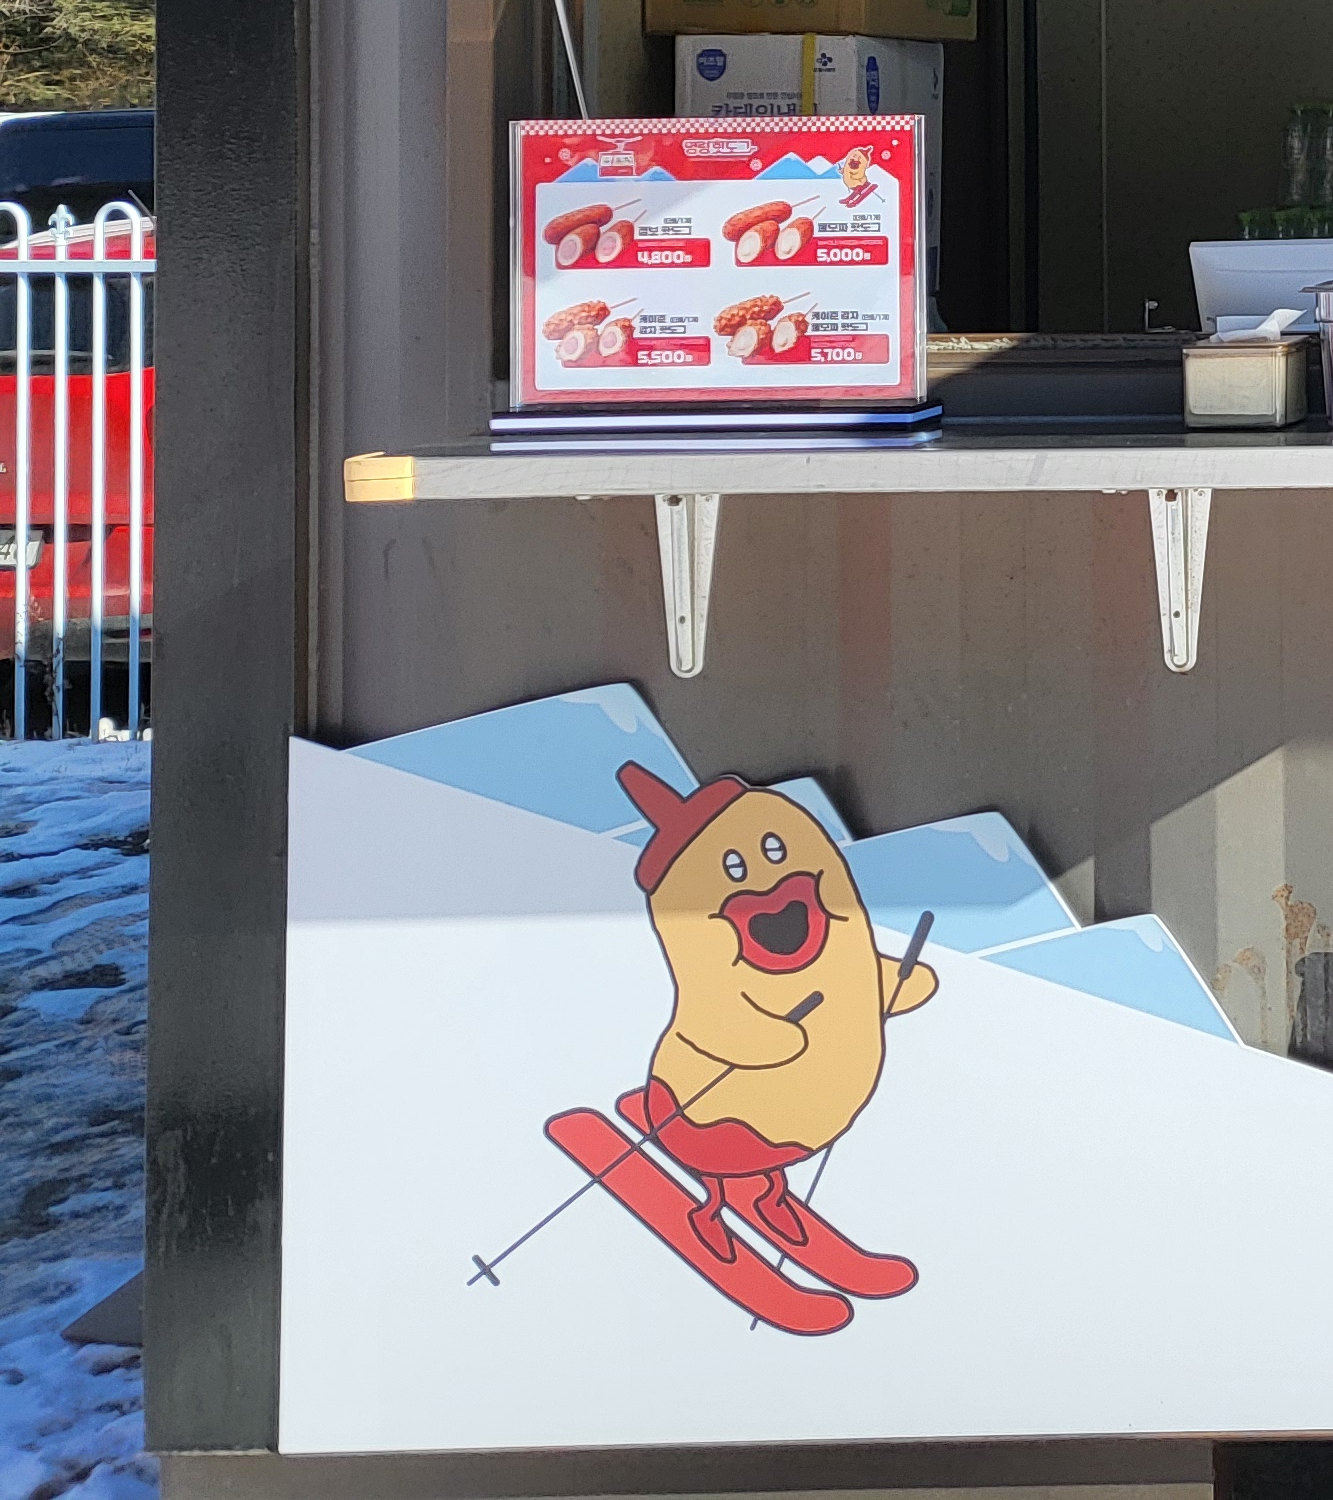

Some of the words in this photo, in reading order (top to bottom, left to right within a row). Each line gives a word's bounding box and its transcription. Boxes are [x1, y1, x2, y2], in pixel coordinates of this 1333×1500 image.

[660, 225, 692, 236] 핫도그
[850, 222, 881, 233] 핫도그
[840, 310, 859, 320] 감자
[658, 324, 687, 335] 핫도그
[840, 322, 868, 332] 핫도그
